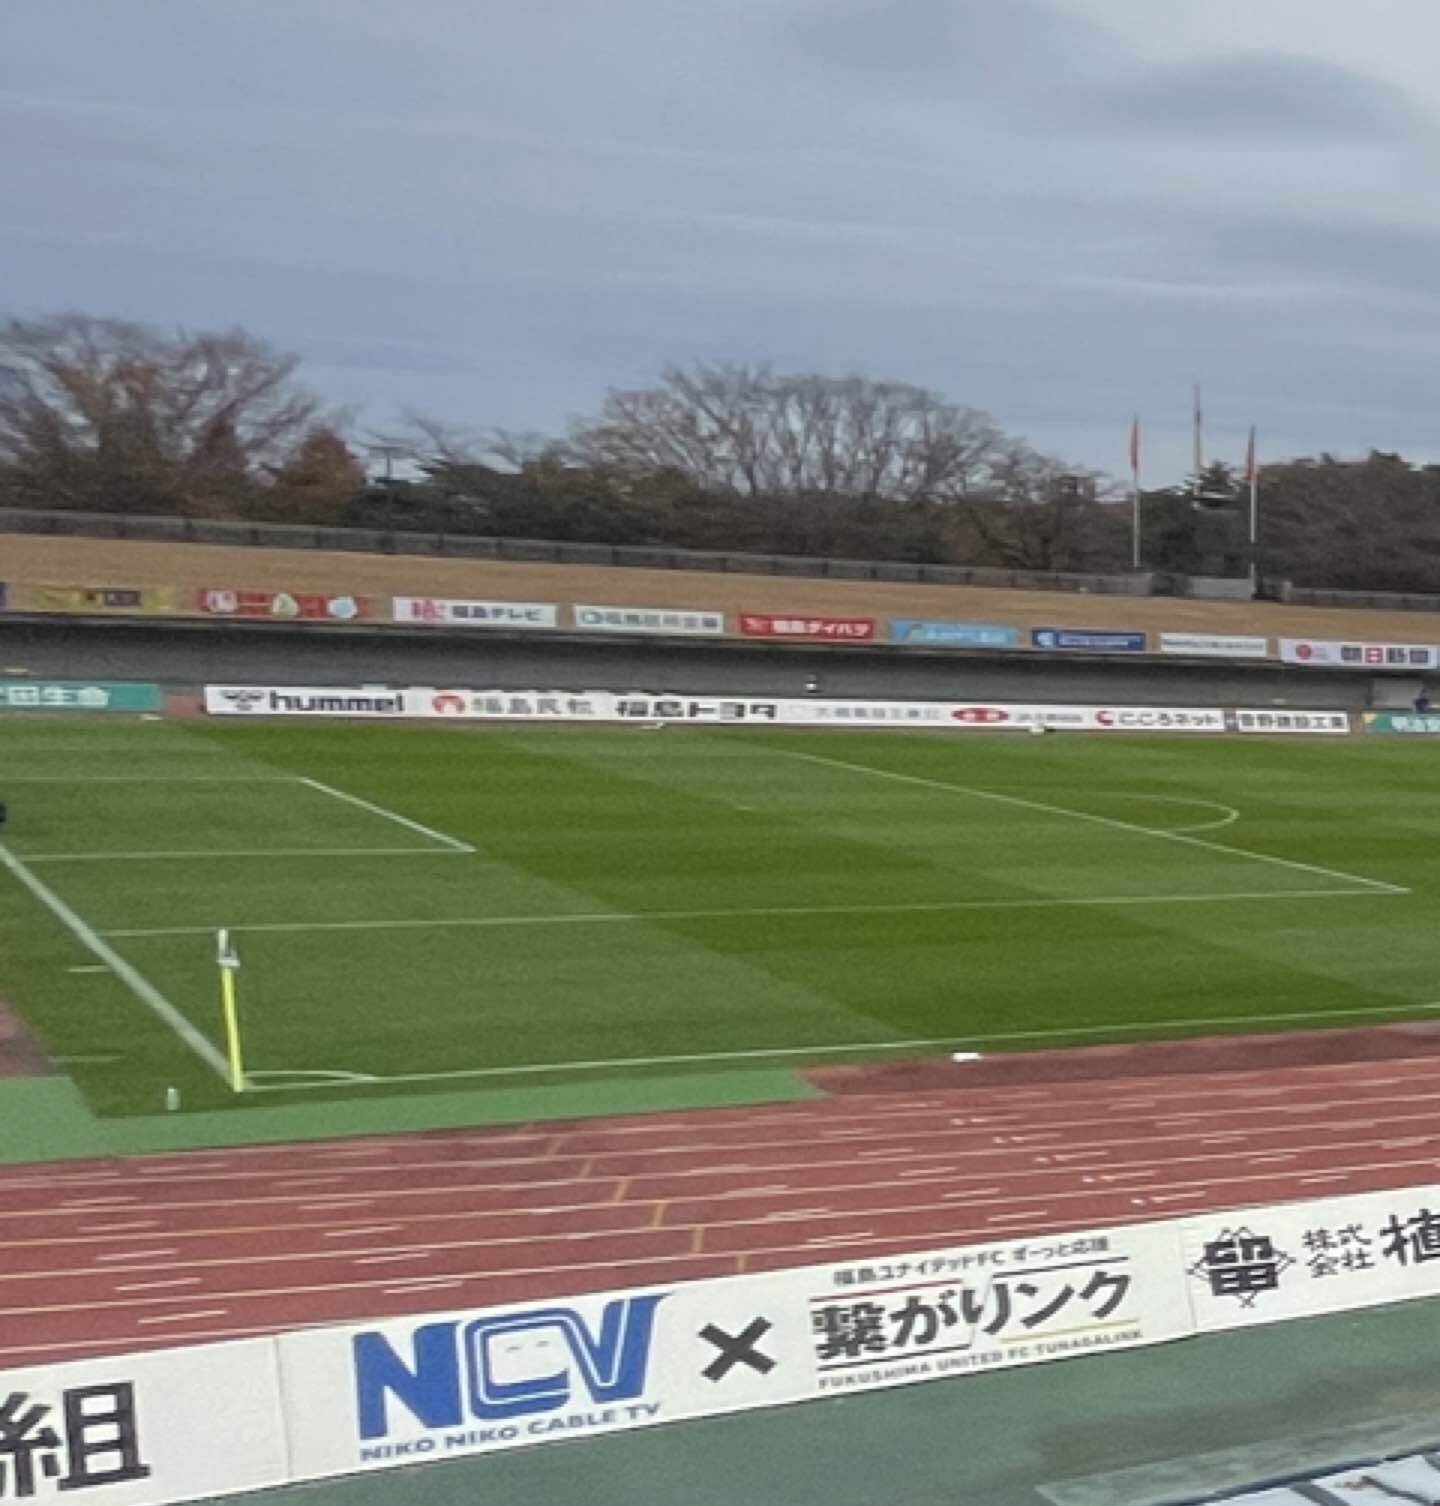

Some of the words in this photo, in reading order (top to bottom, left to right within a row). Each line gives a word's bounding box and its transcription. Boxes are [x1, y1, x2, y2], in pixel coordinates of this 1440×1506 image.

[0, 686, 109, 707] 田生命
[269, 690, 403, 714] hummel
[616, 701, 777, 719] 福島トヨタ
[353, 1293, 670, 1440] NCV
[818, 1361, 932, 1389] FUKUSHIMA
[936, 1350, 1003, 1372] UNITED
[1008, 1345, 1030, 1359] FC
[0, 1381, 150, 1498] 組
[361, 1438, 435, 1462] NIKO
[446, 1426, 520, 1448] NIKO
[528, 1410, 615, 1435] CABLE
[620, 1403, 661, 1420] TV
